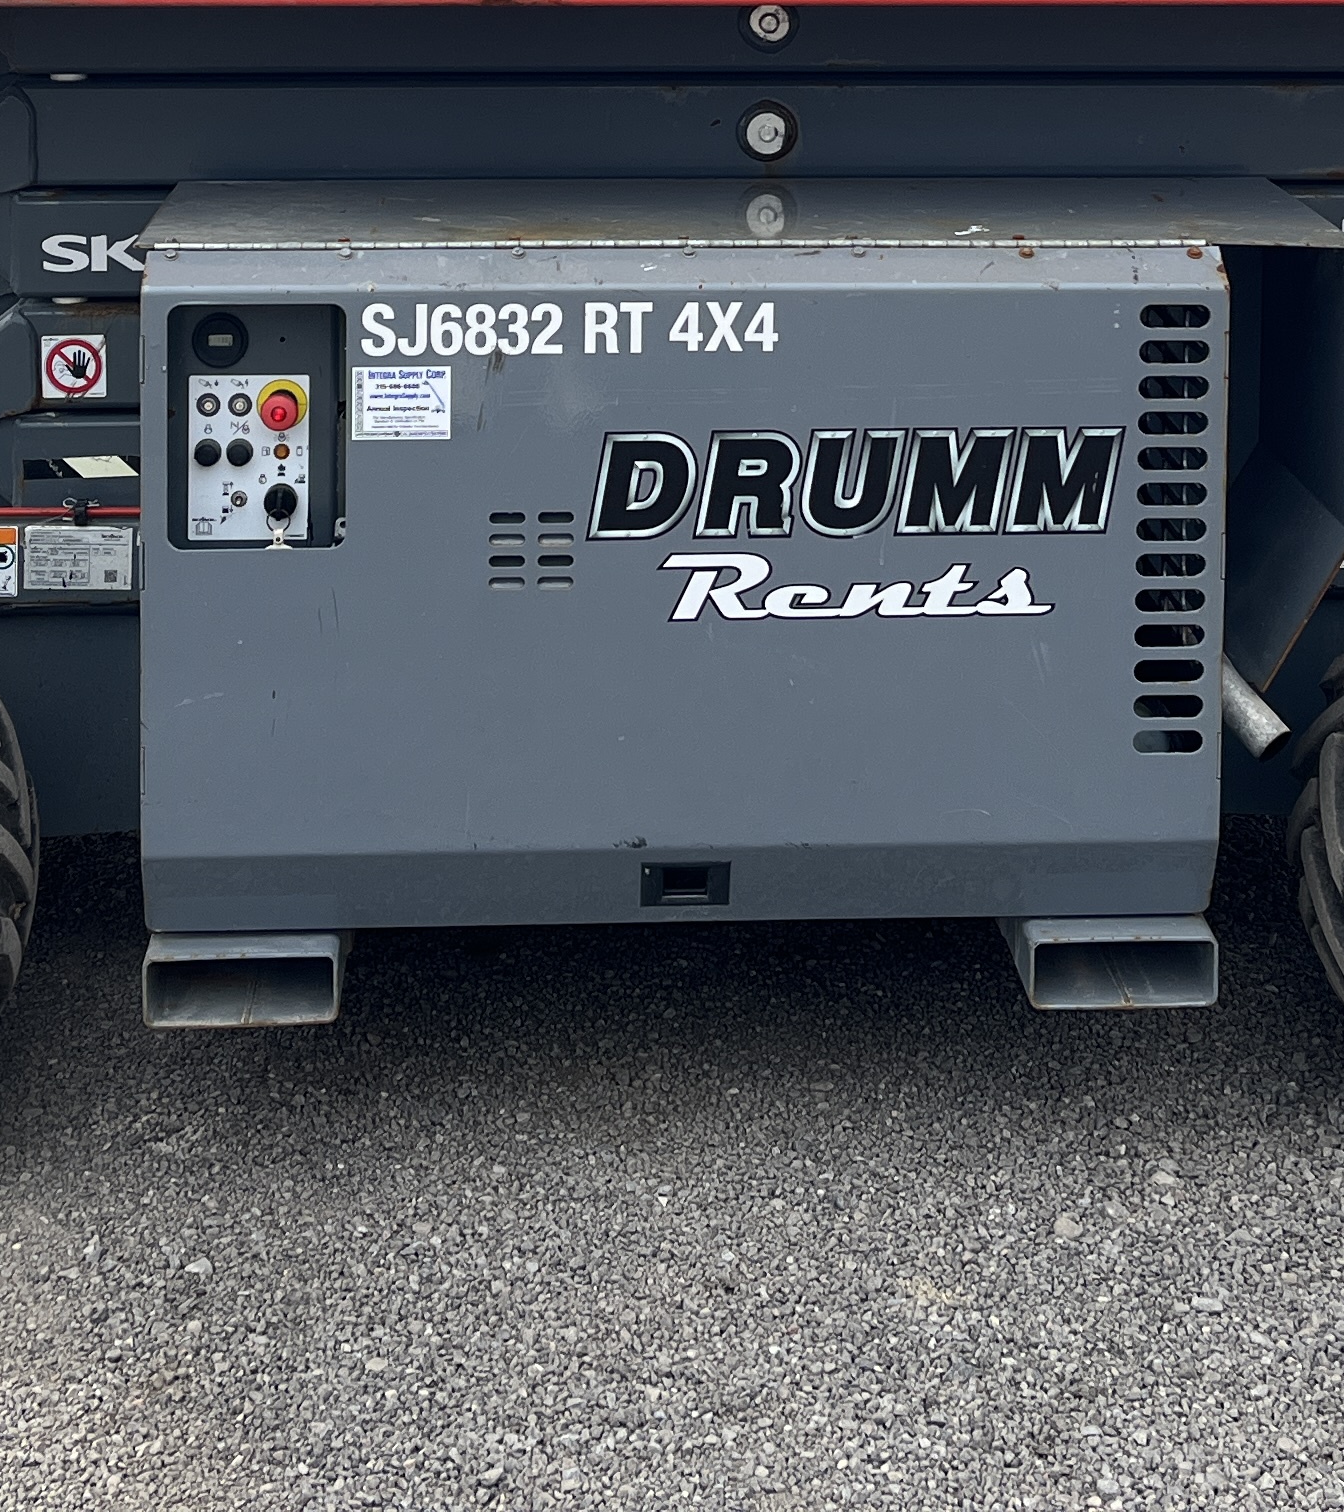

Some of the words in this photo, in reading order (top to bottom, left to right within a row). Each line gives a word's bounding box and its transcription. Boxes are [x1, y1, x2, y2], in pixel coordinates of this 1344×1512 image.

[360, 302, 564, 357] SJ6832
[584, 301, 654, 354] RT
[668, 301, 779, 353] 4X4
[586, 425, 1126, 540] DRUMM
[657, 551, 1055, 622] Rents
